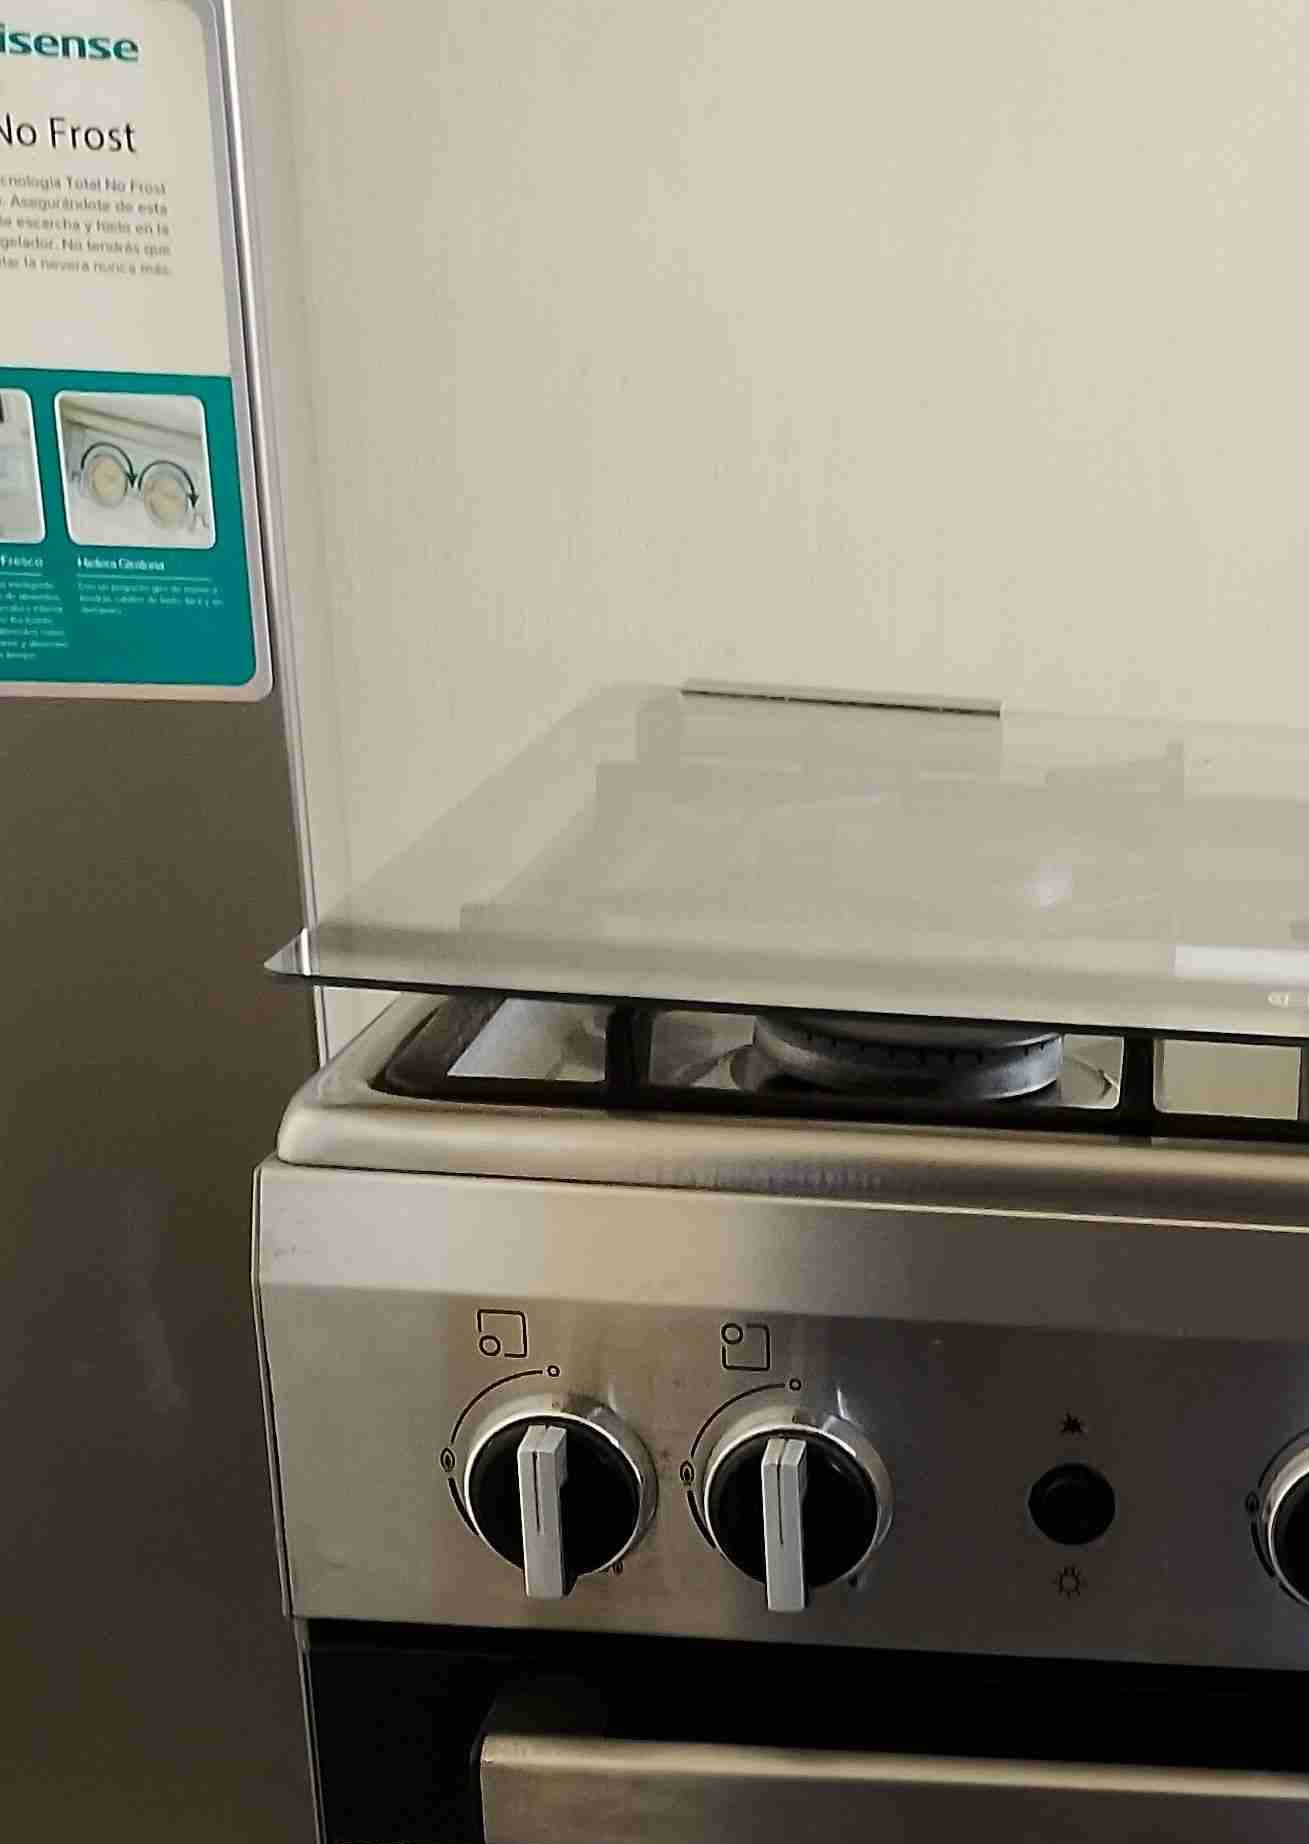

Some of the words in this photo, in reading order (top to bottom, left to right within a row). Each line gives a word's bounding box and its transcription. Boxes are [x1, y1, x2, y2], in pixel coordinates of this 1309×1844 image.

[0, 112, 37, 147] No
[50, 117, 137, 153] Frost
[105, 178, 126, 192] No
[130, 178, 167, 194] Frost
